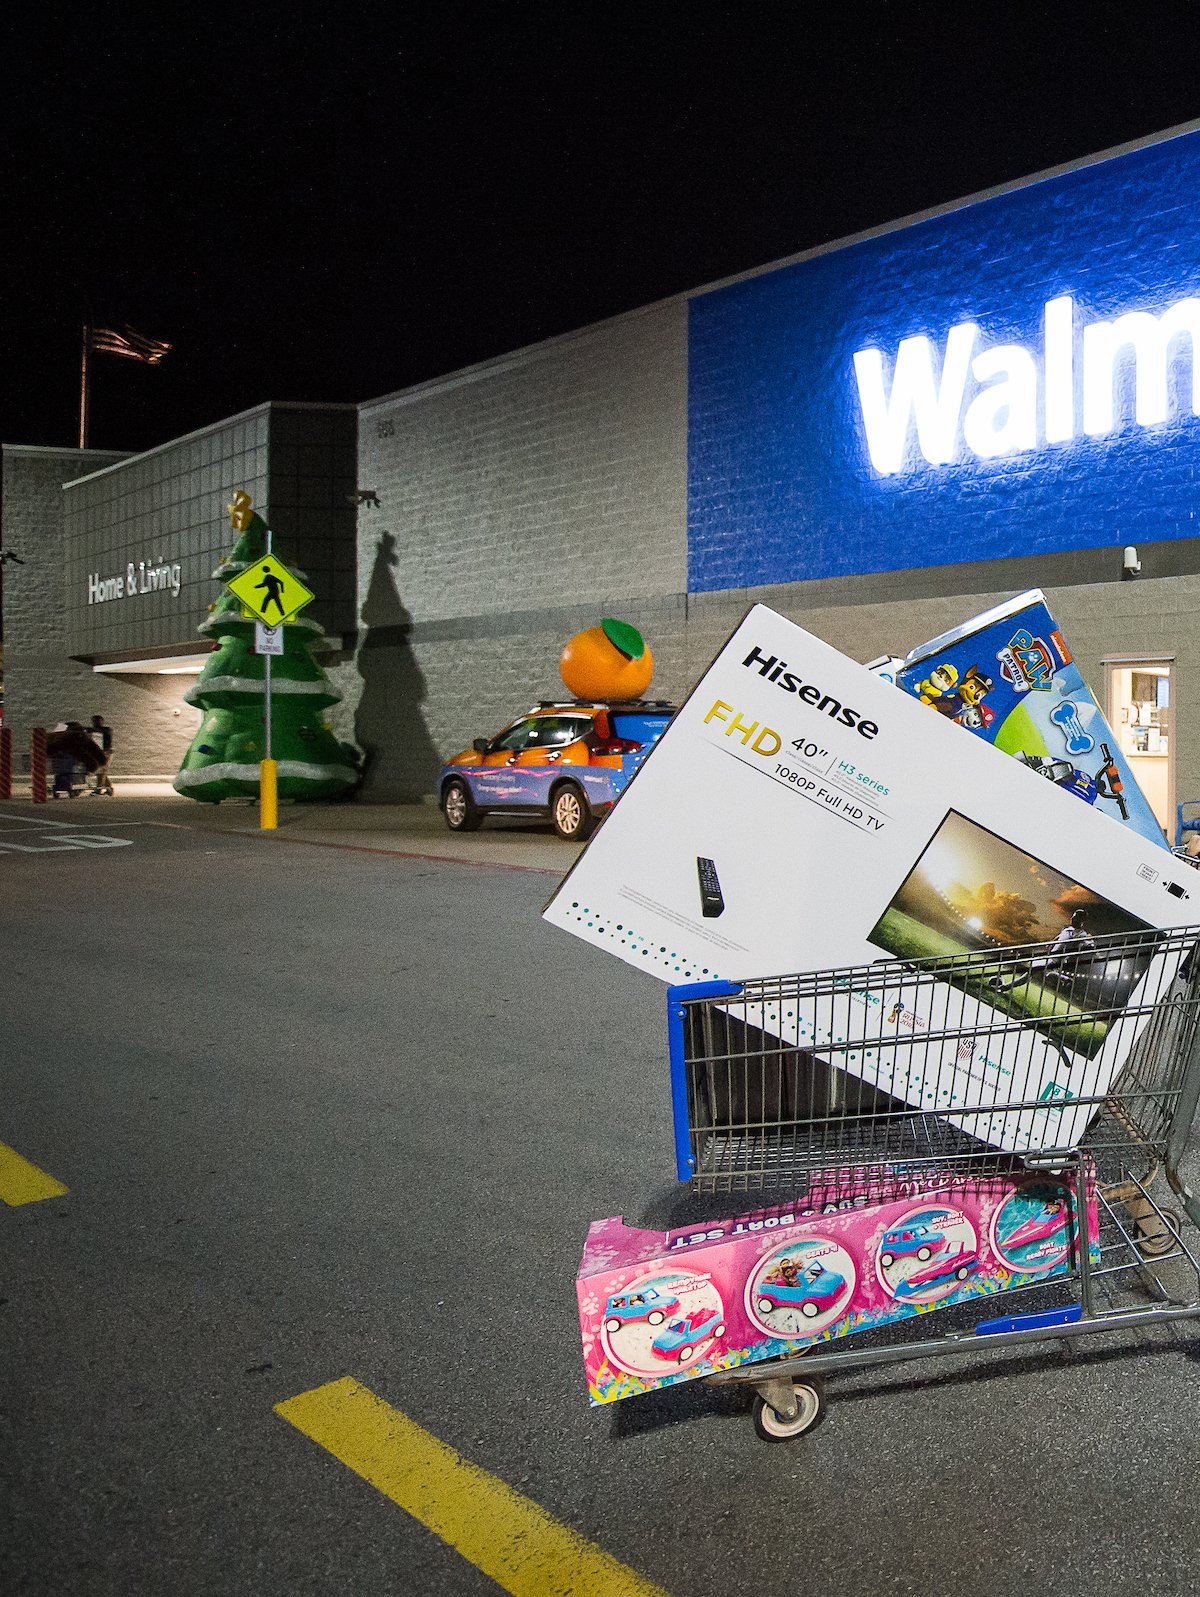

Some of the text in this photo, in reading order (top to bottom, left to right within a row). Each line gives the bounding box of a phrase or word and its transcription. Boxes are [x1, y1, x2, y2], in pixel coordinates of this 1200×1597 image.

[89, 556, 181, 604] Home & Living
[1002, 653, 1025, 686] PATROL
[1008, 628, 1053, 692] PAW
[741, 646, 879, 740] Hisense
[703, 699, 782, 757] FHD
[774, 763, 816, 791] 1080P
[816, 789, 842, 808] Full
[842, 803, 863, 819] HD
[866, 816, 885, 831] TV
[838, 761, 856, 775] H3
[856, 773, 890, 796] series
[671, 1195, 868, 1249] SUV + BOAT SET
